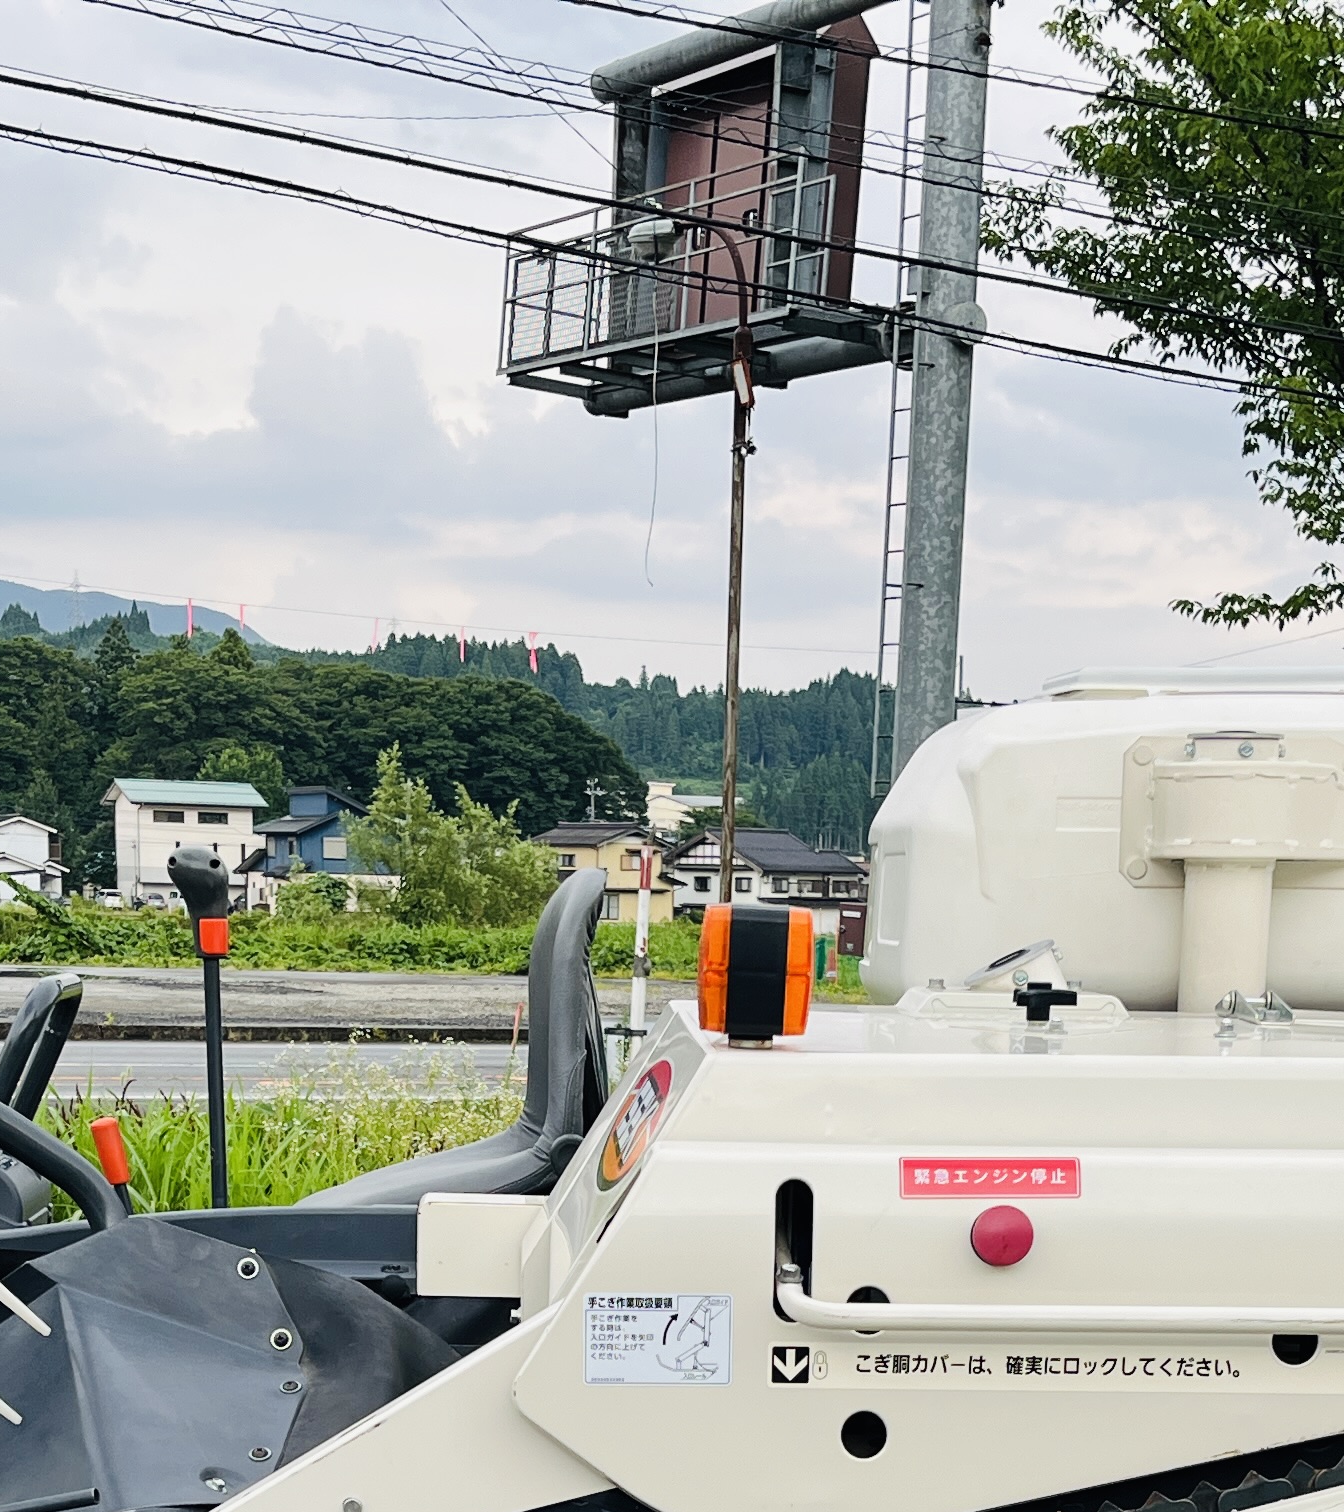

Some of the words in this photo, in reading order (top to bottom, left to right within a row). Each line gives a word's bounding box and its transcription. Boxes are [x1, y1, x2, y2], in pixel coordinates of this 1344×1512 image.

[914, 1168, 1067, 1185] 緊急エンジン停止
[855, 1353, 1241, 1377] こぎ胴カバーは、確実にロックしてください。
